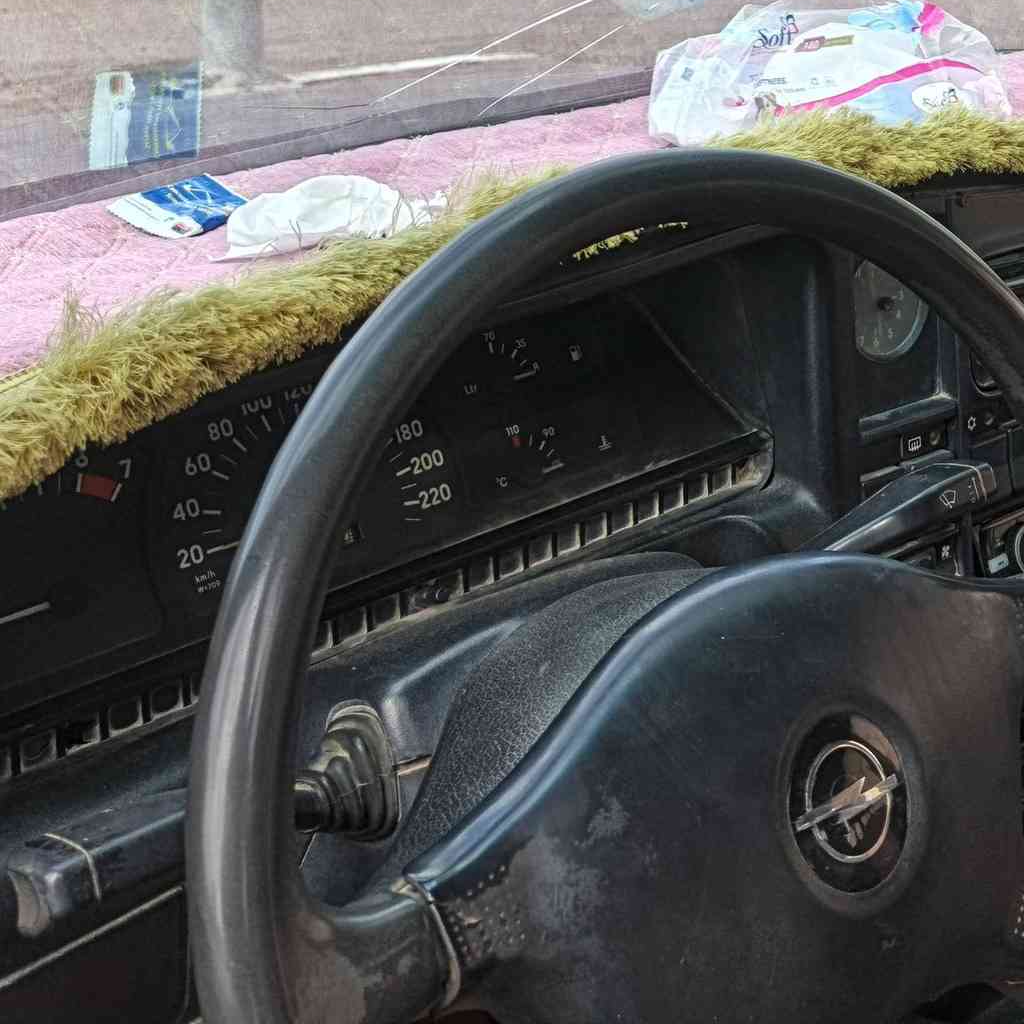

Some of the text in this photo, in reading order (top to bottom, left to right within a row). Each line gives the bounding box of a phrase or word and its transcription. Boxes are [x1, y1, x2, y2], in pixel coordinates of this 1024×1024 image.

[207, 418, 234, 441] 80
[394, 419, 424, 444] 180
[117, 458, 131, 479] 7
[184, 452, 212, 476] 60
[410, 449, 444, 475] 200
[418, 483, 452, 510] 220
[172, 498, 200, 521] 40
[176, 543, 204, 569] 20
